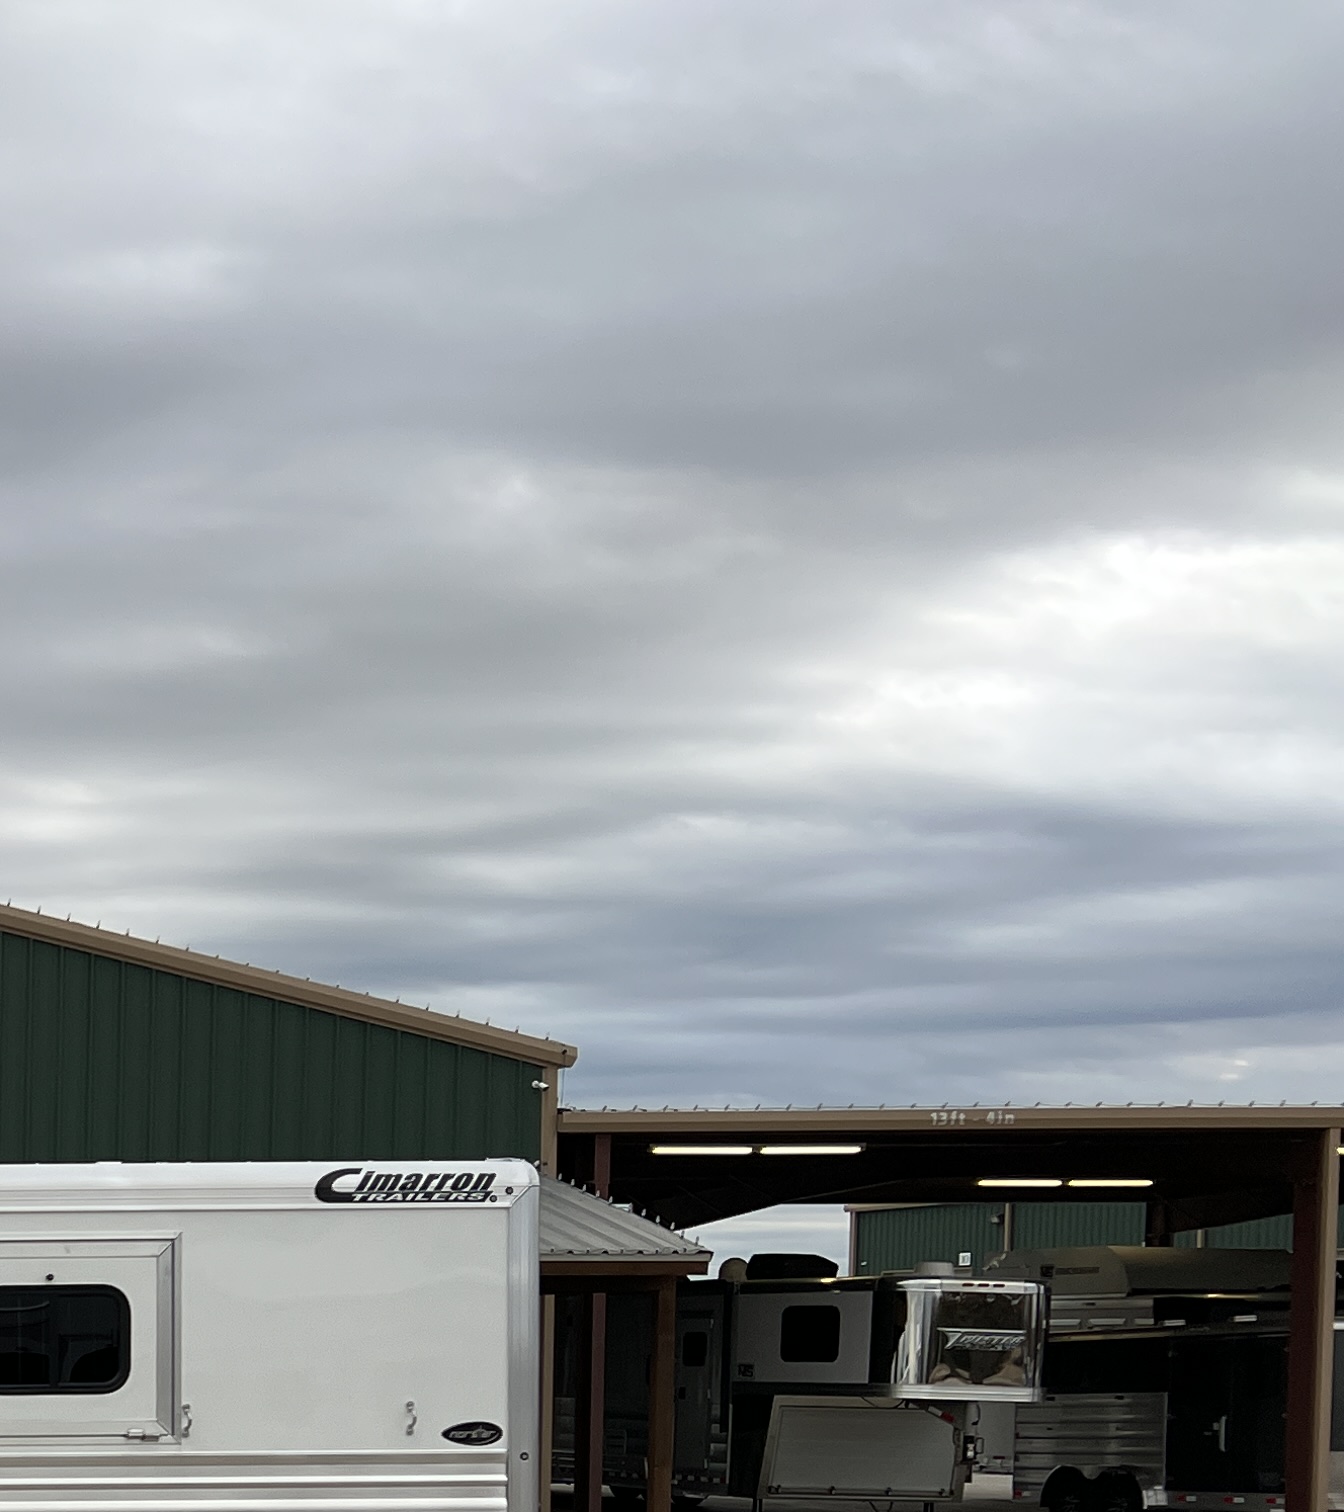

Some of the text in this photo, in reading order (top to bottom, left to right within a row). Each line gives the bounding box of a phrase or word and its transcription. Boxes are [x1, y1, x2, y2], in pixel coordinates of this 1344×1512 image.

[930, 1110, 966, 1126] 13ft
[985, 1110, 1016, 1125] 4in
[314, 1167, 497, 1203] Cimarron
[351, 1192, 486, 1202] TRAILERS
